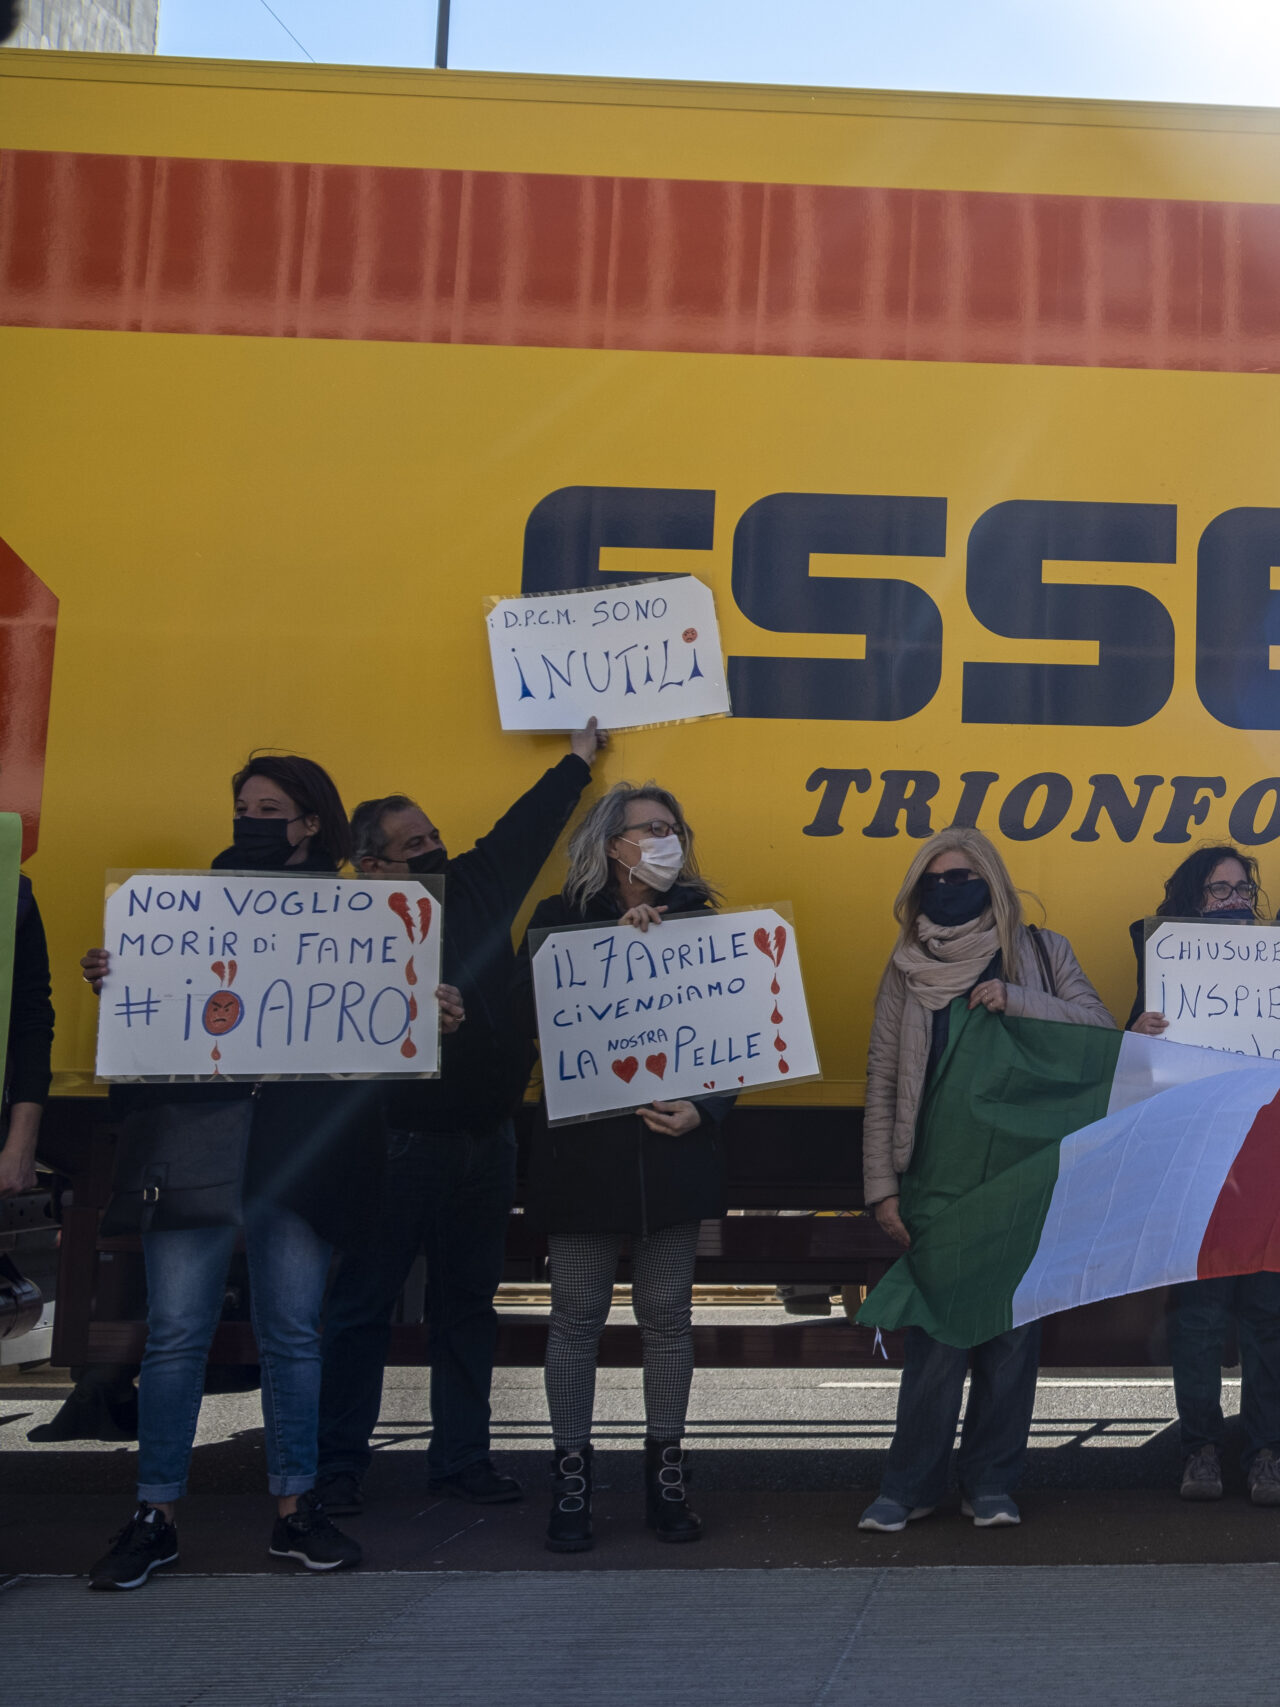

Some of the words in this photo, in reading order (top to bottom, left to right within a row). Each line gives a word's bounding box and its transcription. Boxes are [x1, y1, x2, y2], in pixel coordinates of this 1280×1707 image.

[592, 598, 668, 626] SONO
[128, 886, 202, 917] NON
[296, 932, 398, 965] FAME
[558, 1049, 599, 1081] LA
[607, 1028, 669, 1052] NOSTRA
[674, 1025, 762, 1073] PELLE
